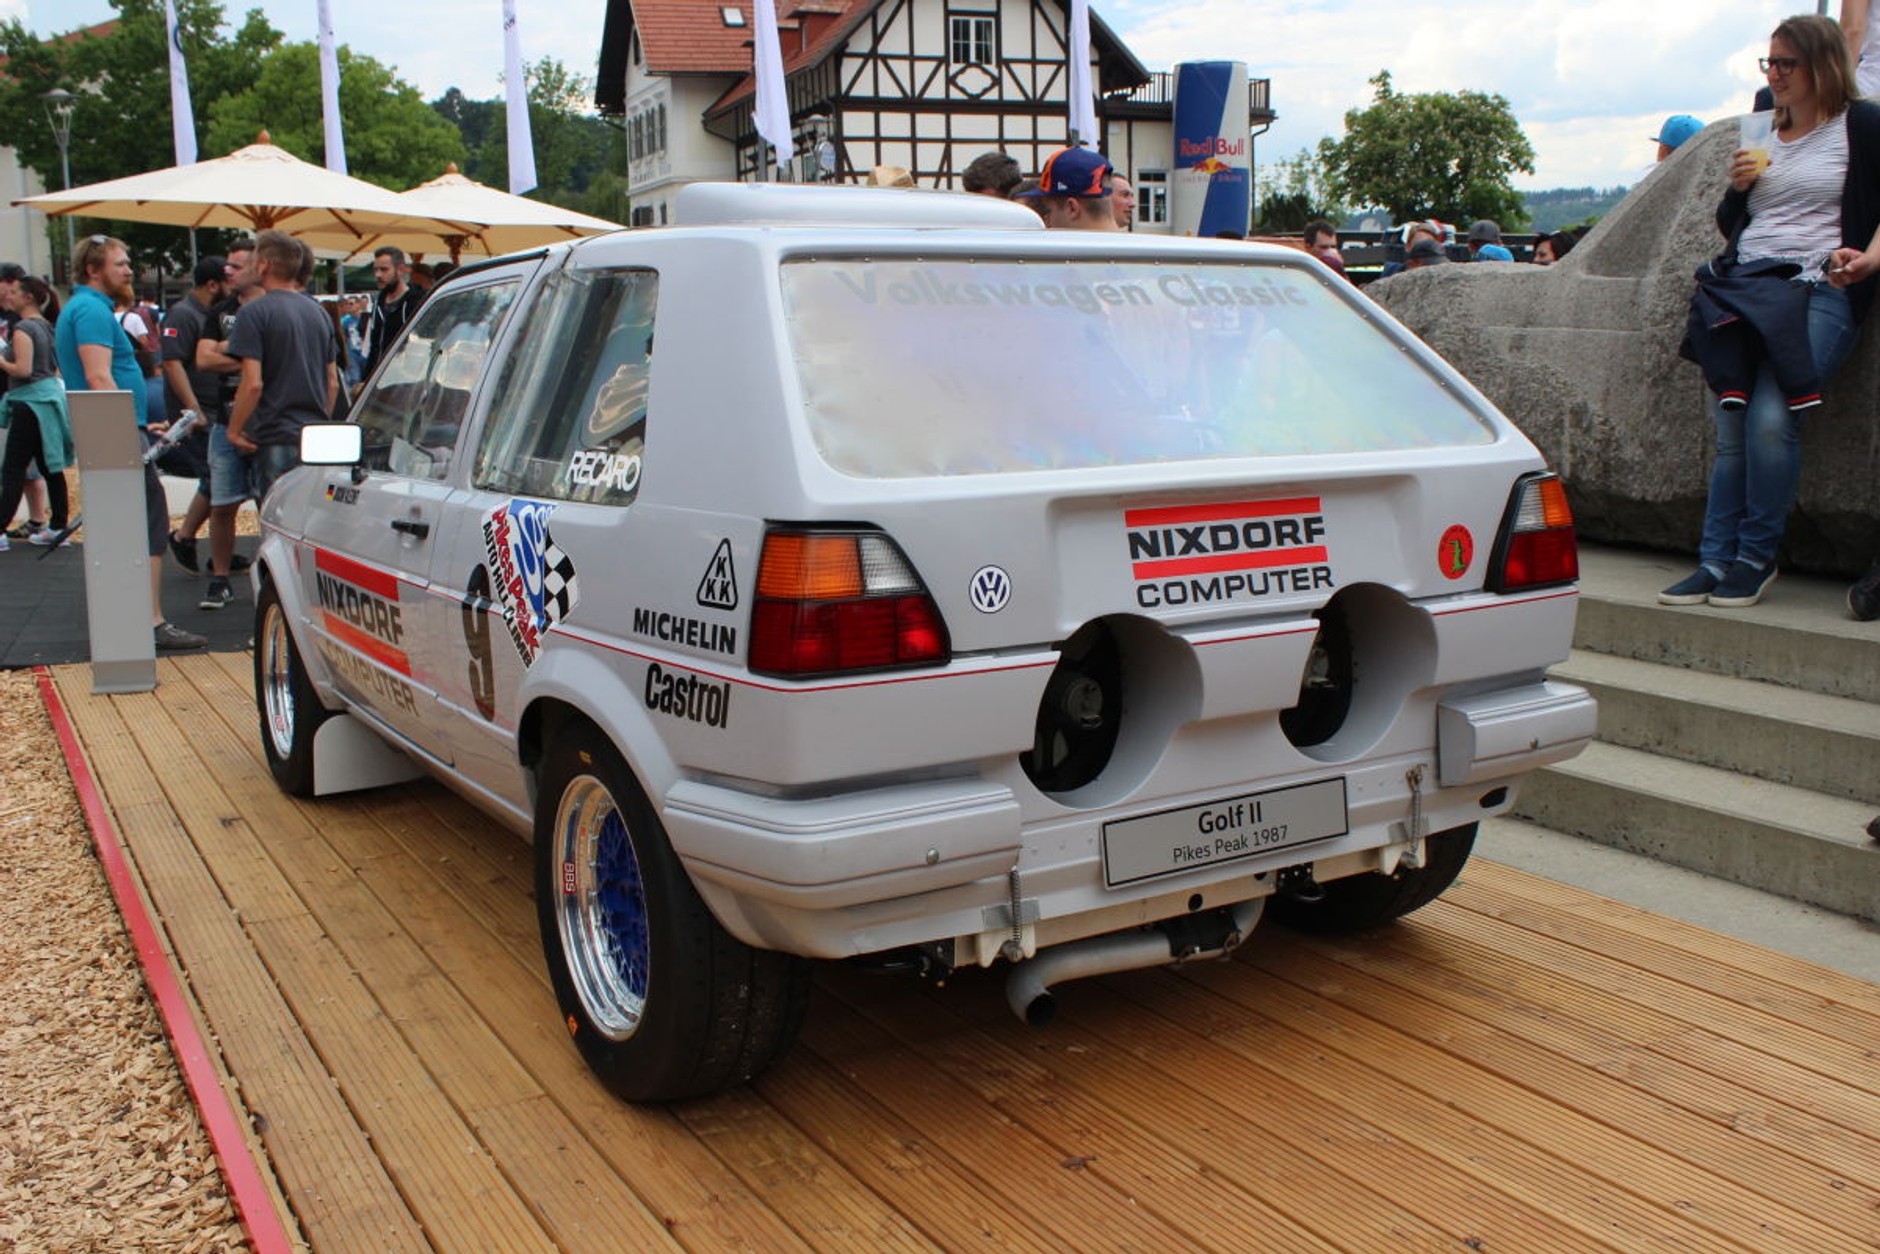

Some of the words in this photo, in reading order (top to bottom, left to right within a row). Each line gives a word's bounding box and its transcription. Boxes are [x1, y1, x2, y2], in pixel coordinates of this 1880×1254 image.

[1180, 138, 1212, 155] Red
[1216, 138, 1244, 155] Bull
[834, 270, 1152, 314] Volkswagen
[1157, 273, 1306, 307] Classic
[566, 451, 641, 492] RECARO
[1127, 516, 1325, 560] NIXDORF
[315, 571, 404, 645] NIXDORF
[482, 520, 498, 567] AUTO
[492, 566, 509, 608] HILL
[503, 605, 533, 669] CLIMB
[1136, 566, 1334, 608] COMPUTER
[462, 563, 495, 722] 9
[633, 607, 737, 655] MICHELIN
[318, 636, 420, 718] COMPUTER
[645, 662, 731, 729] Castrol
[1198, 803, 1243, 834] Golf
[1249, 800, 1263, 824] II
[1173, 846, 1211, 863] Pikes
[1215, 836, 1249, 855] Peak
[1253, 825, 1288, 847] 1987
[564, 862, 576, 892] BBS
